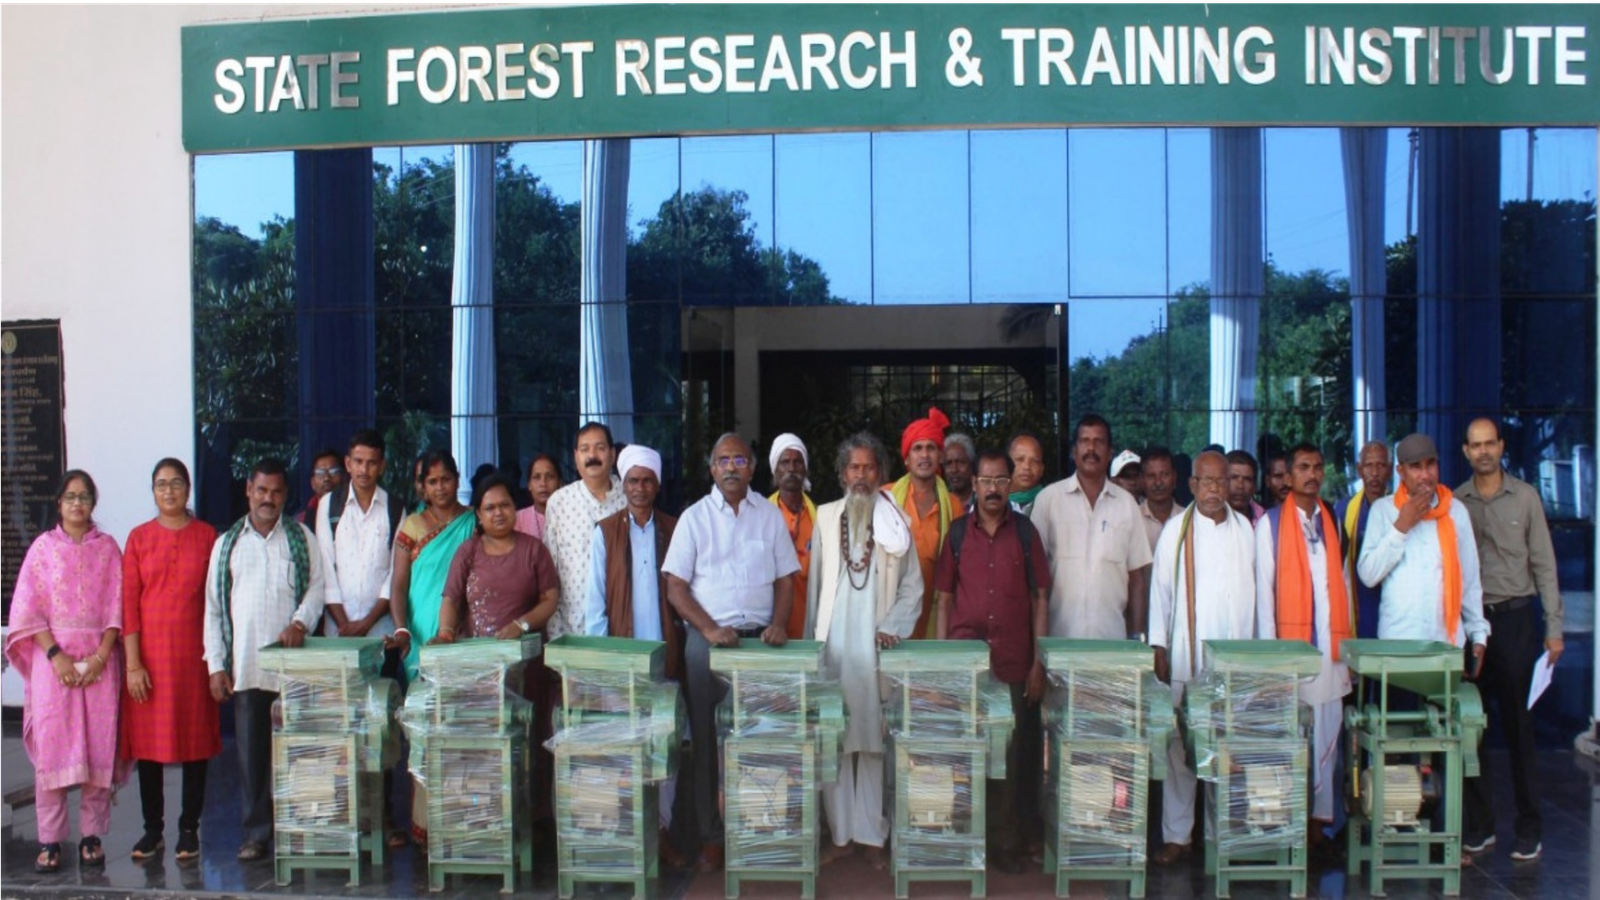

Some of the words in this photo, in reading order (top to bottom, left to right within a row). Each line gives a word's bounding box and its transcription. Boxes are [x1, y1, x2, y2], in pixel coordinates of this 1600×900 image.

[214, 52, 360, 113] STATE
[387, 42, 594, 106] FOREST
[616, 31, 917, 96] RESEARCH
[945, 27, 983, 87] &
[1001, 26, 1276, 87] TRAINING
[1305, 25, 1586, 86] INSTITUTE
